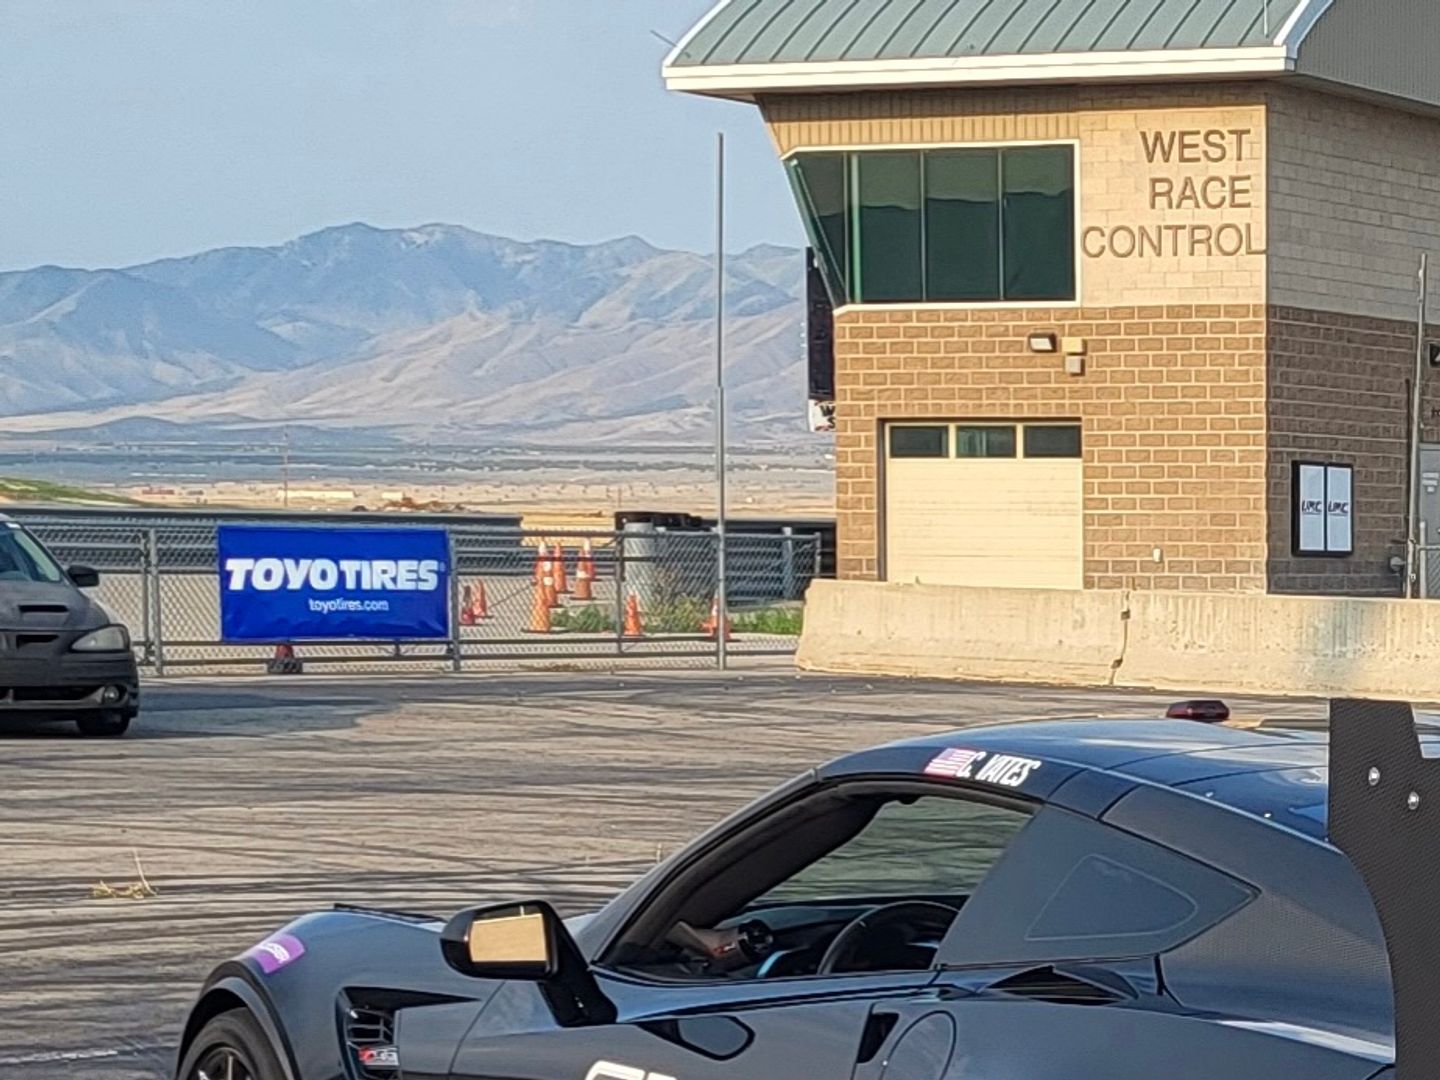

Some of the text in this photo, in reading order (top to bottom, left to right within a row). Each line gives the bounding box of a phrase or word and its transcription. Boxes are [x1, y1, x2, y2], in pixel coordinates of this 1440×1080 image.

[1140, 129, 1251, 163] WEST
[1149, 175, 1251, 209] RACE
[1081, 223, 1268, 258] CONTROL
[225, 557, 439, 591] TOYO TIRES
